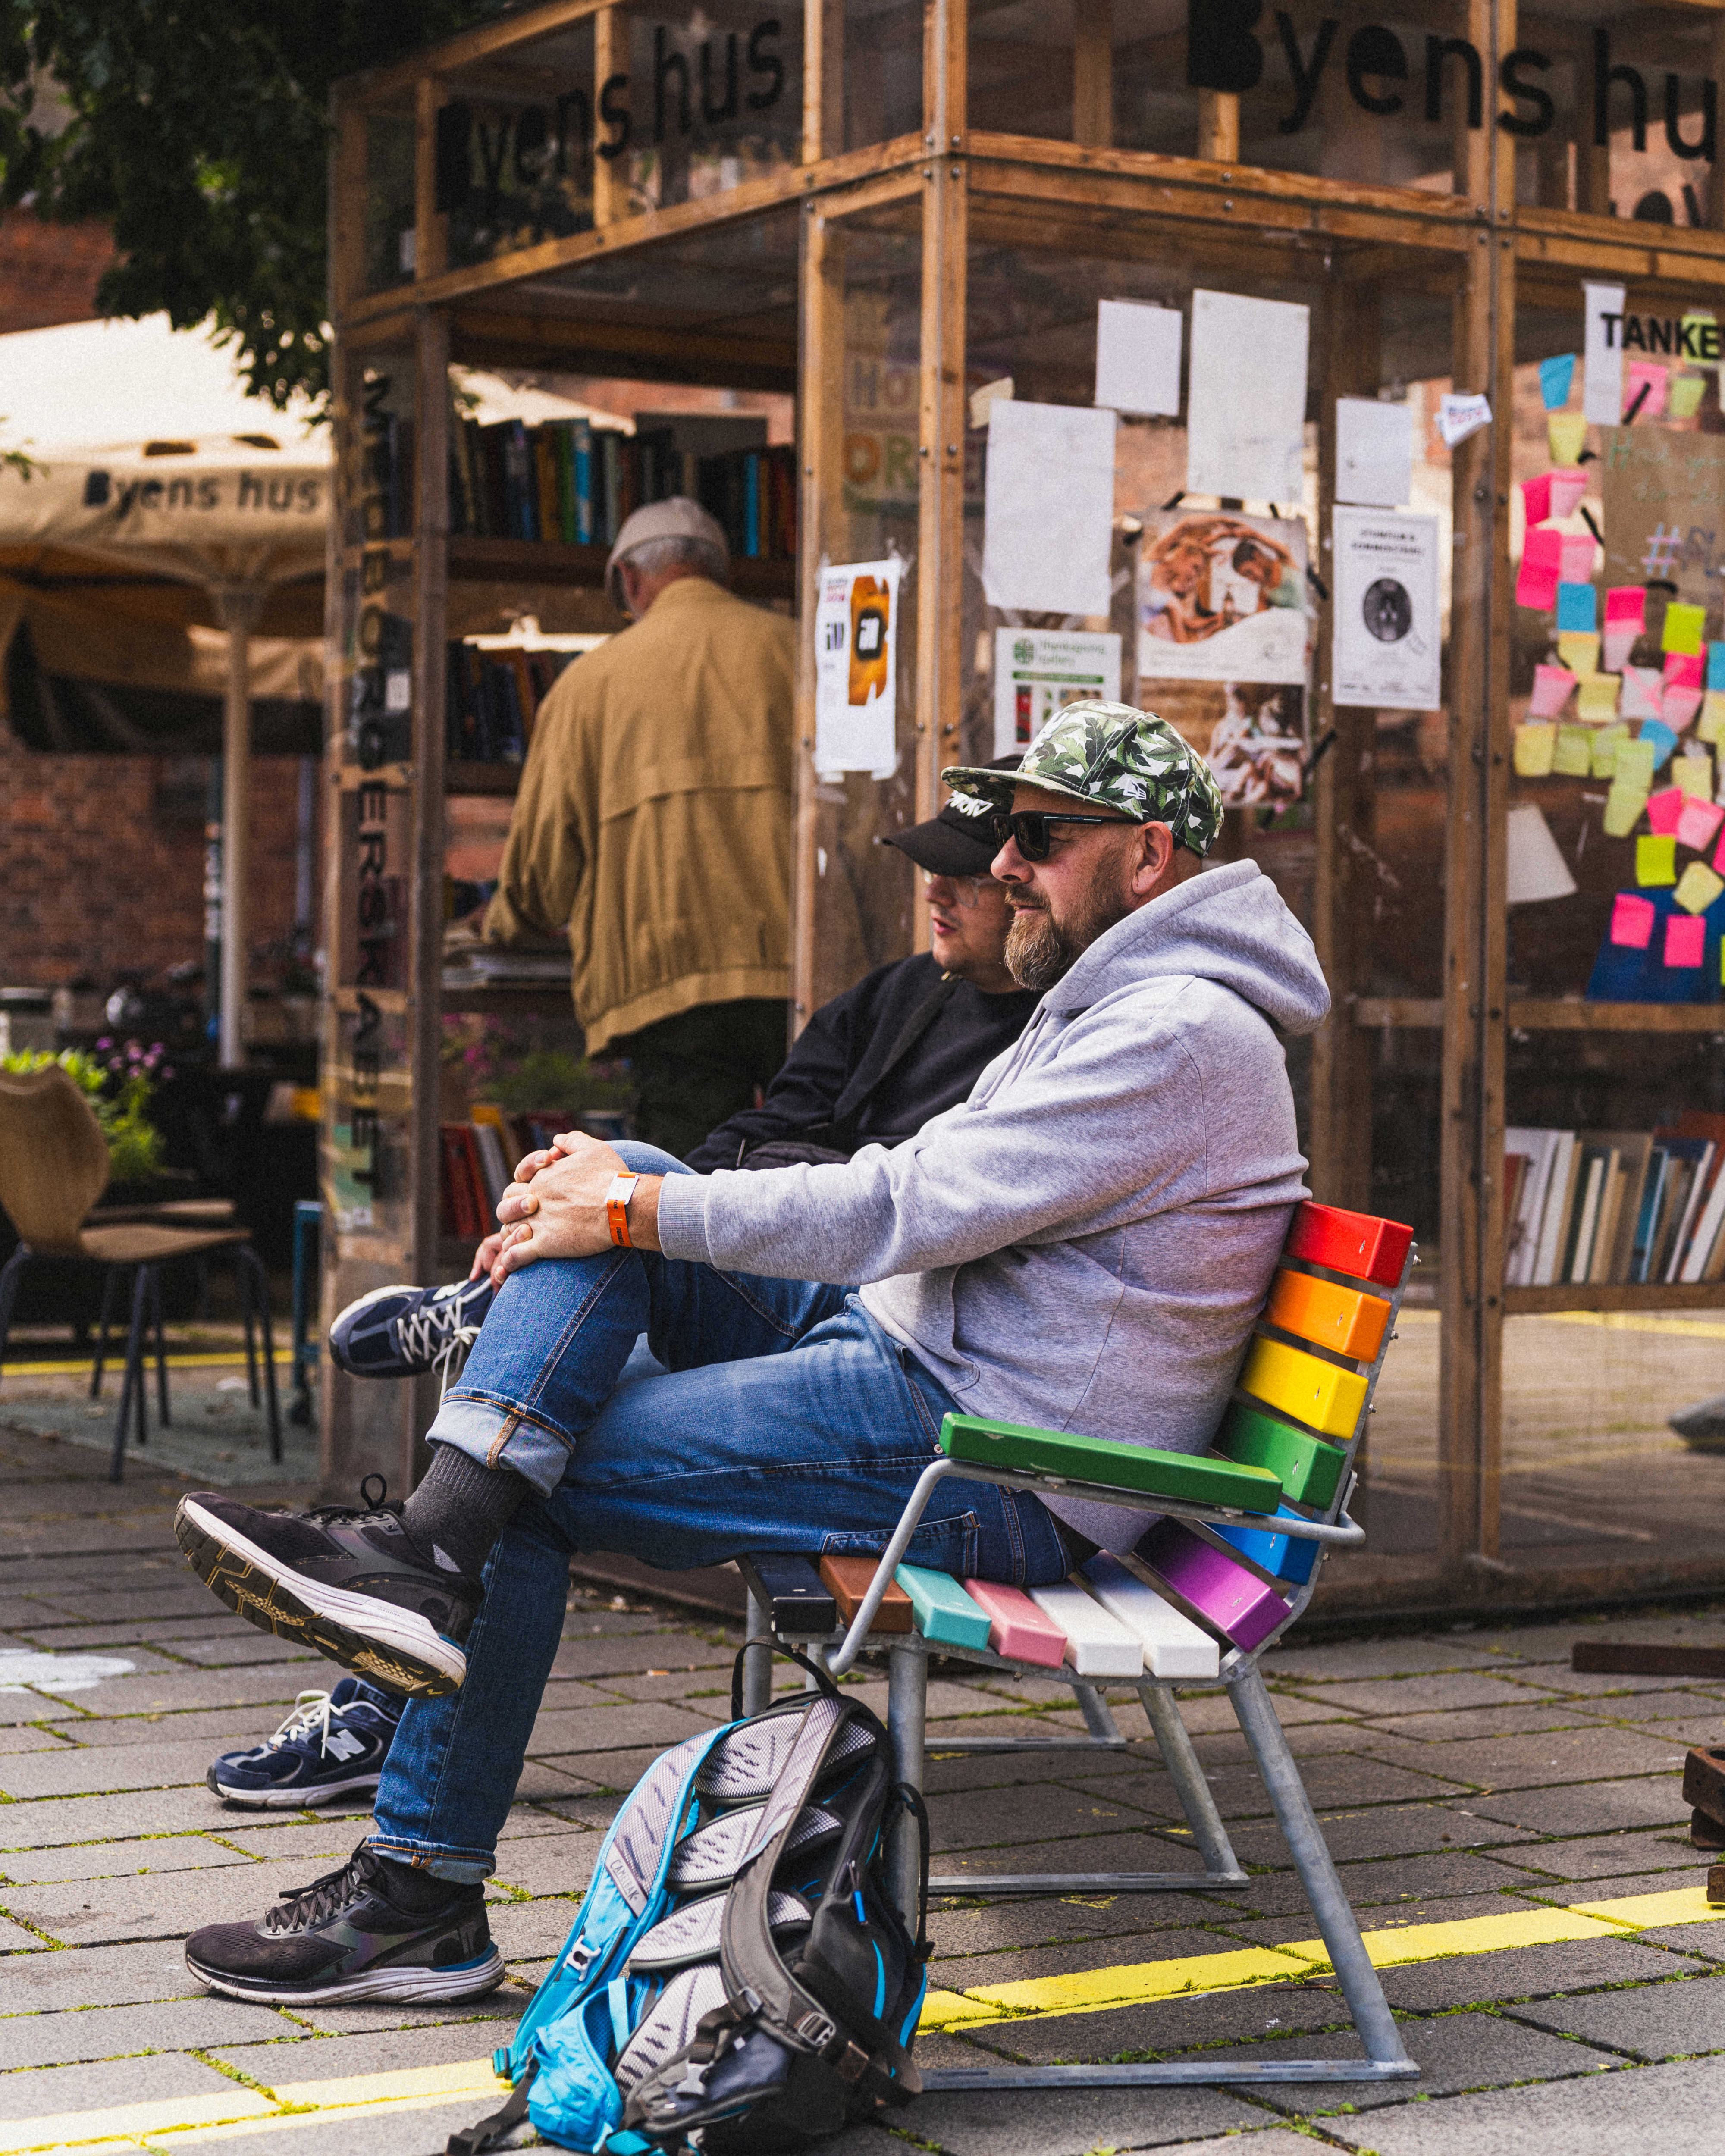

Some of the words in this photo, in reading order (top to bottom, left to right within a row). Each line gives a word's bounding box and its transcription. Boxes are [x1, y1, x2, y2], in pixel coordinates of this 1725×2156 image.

[655, 19, 784, 142] hus
[1187, 0, 1552, 136] Byens
[83, 470, 220, 518] Byens
[237, 470, 319, 513] hus
[321, 1728, 366, 1762] N
[610, 1859, 639, 1900] CAMELBAK
